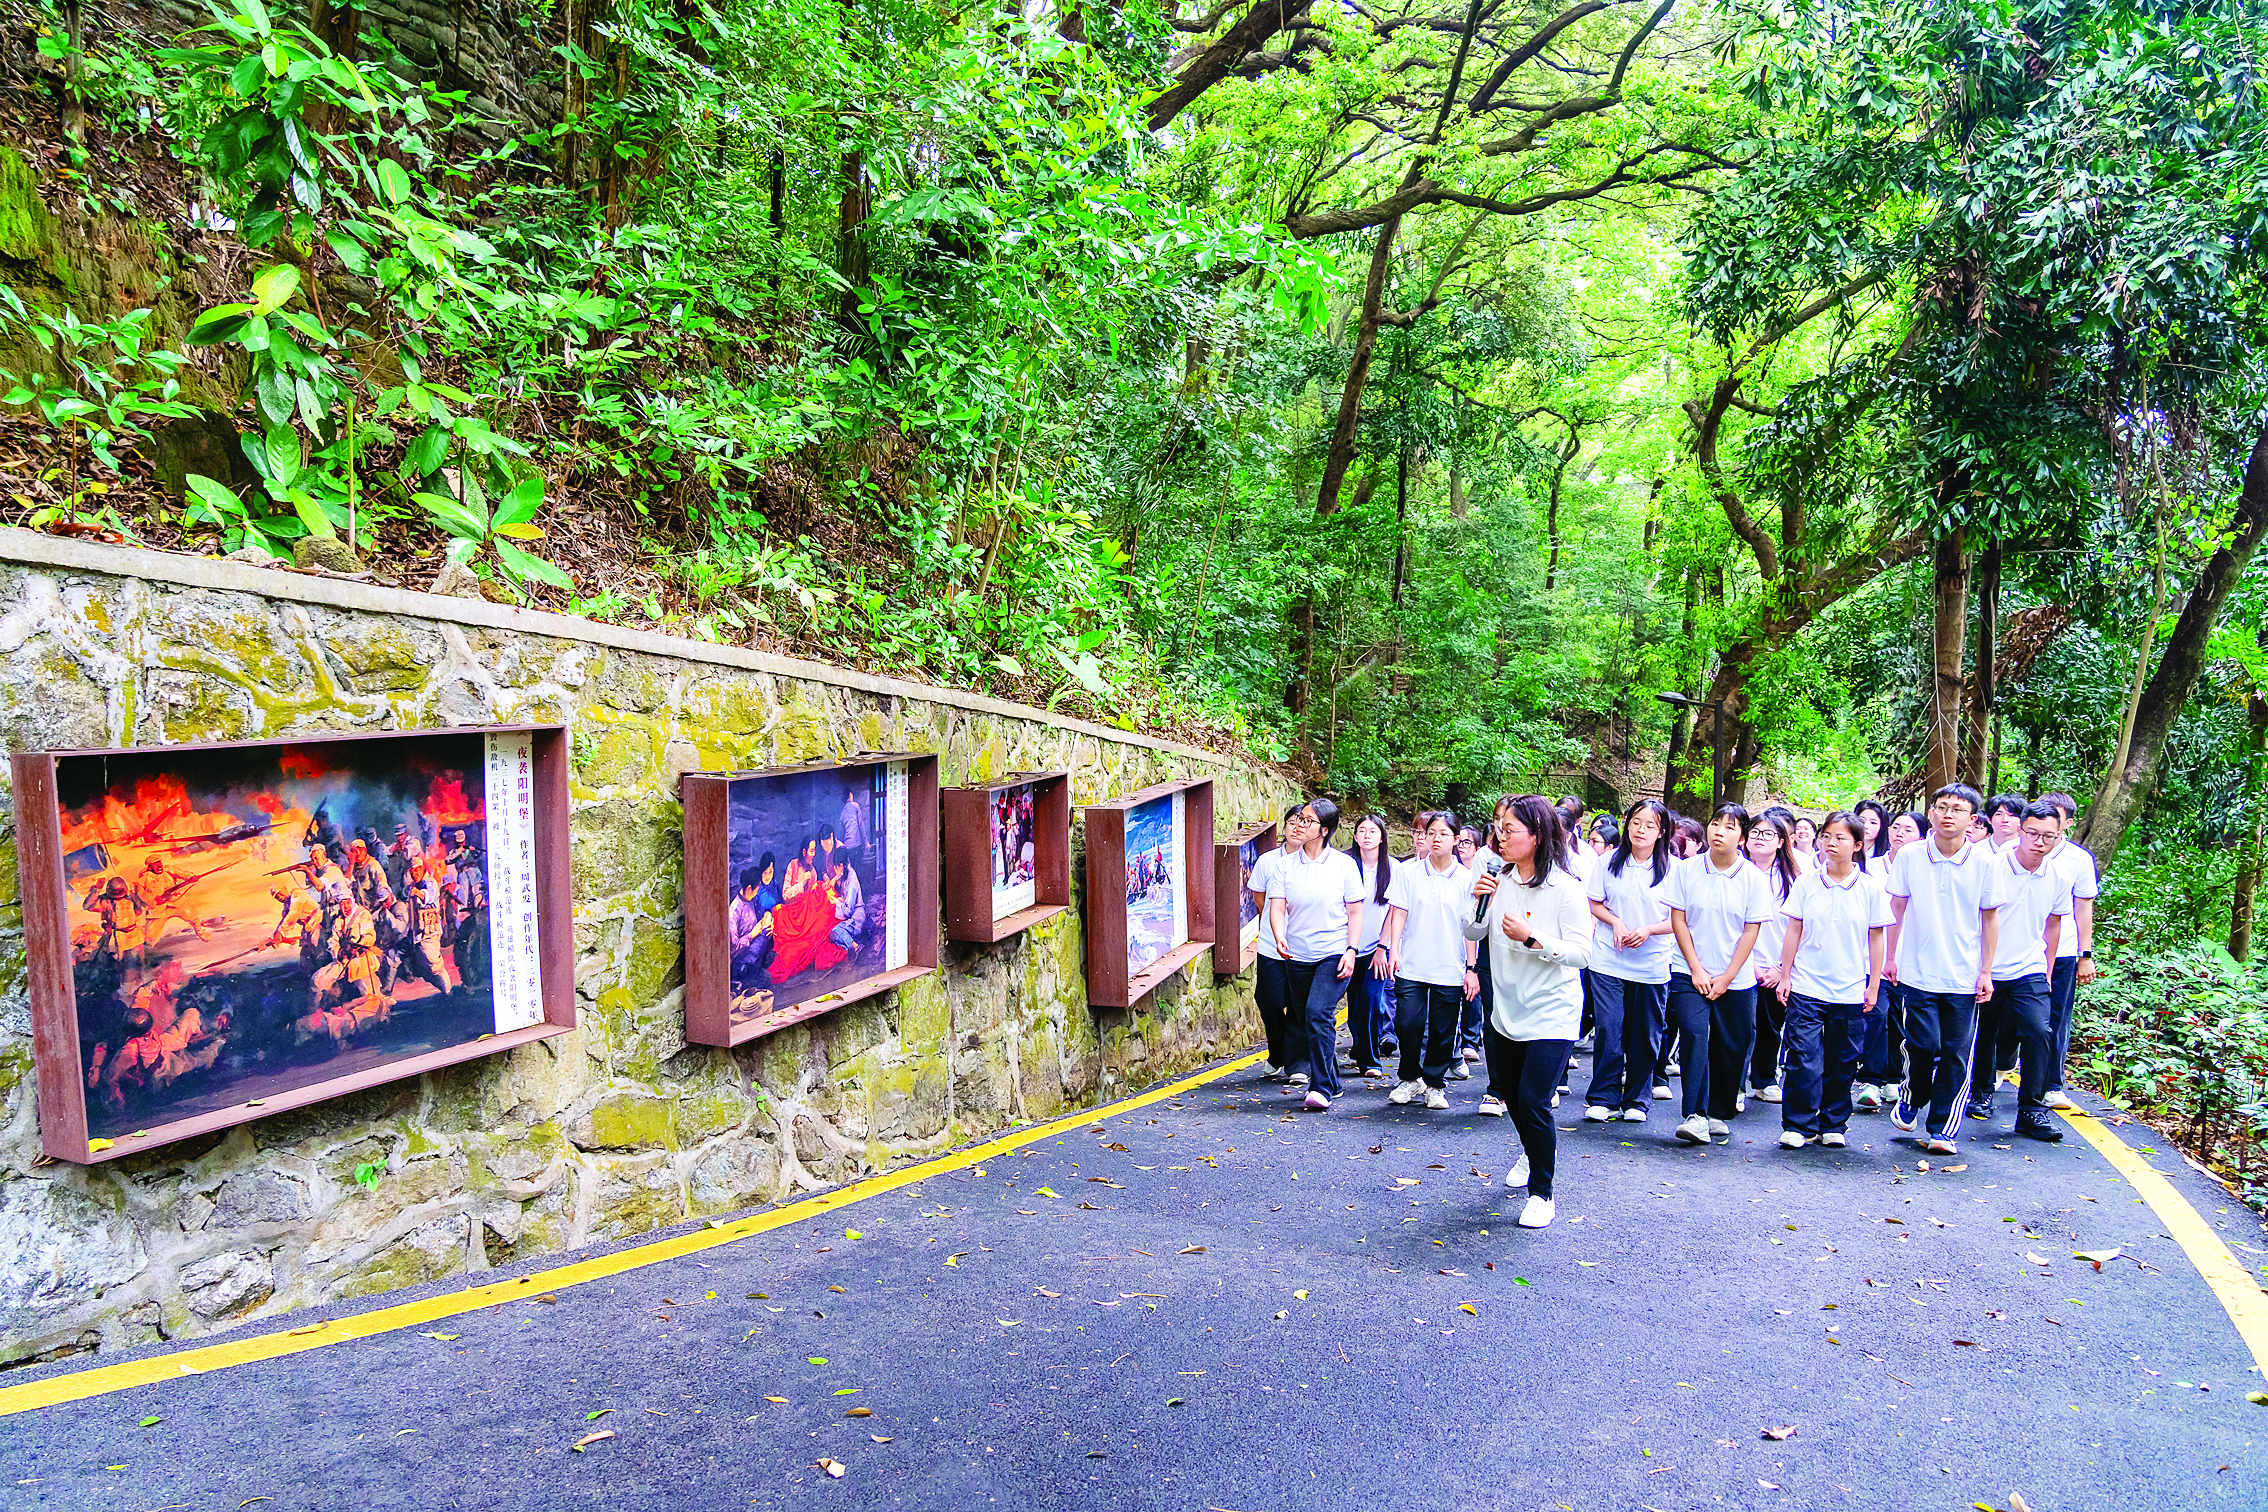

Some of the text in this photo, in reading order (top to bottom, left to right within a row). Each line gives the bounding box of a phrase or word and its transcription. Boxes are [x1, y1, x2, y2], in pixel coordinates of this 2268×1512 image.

[516, 730, 530, 829] 《夜袭阳明堡》
[520, 839, 531, 903] 作者：周武发
